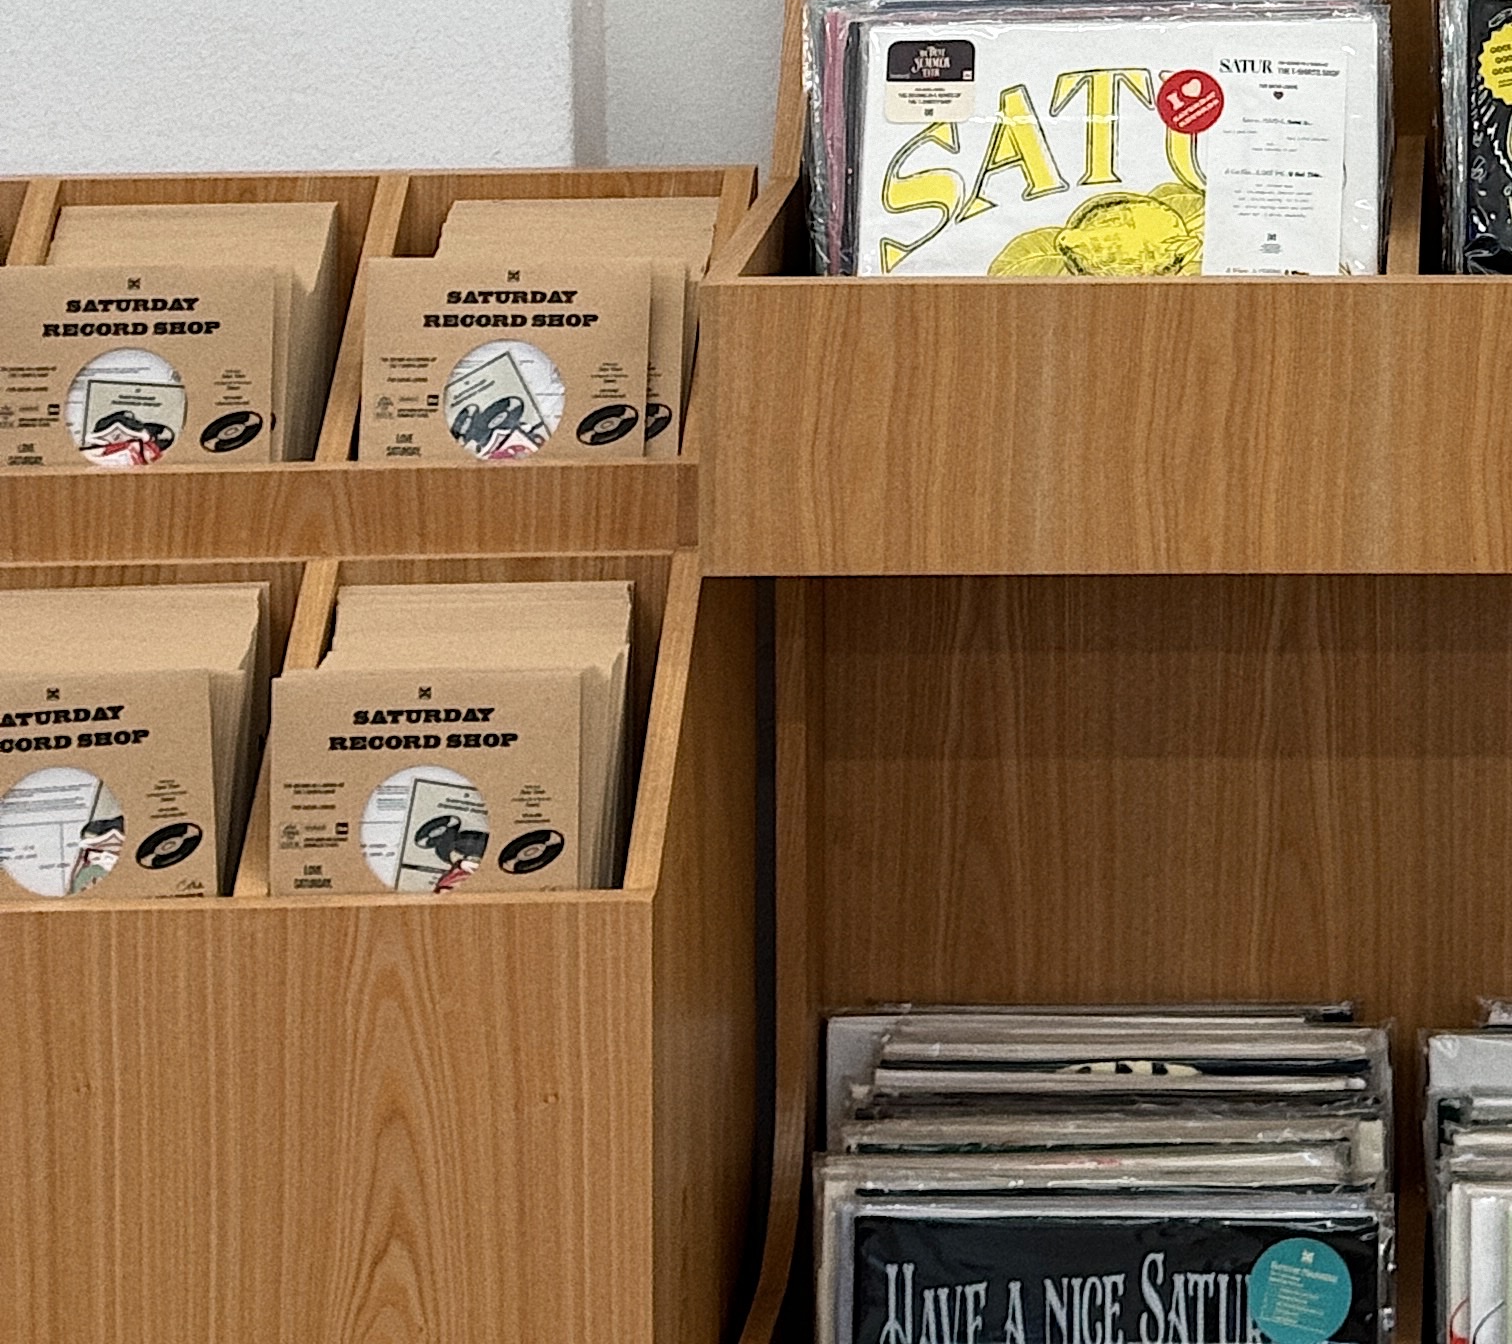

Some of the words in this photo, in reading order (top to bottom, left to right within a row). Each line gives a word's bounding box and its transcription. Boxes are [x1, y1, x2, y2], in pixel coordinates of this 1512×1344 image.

[1219, 58, 1273, 74] SATUR
[65, 296, 200, 313] SATURDAY
[447, 289, 579, 305] SATURDAY
[42, 321, 149, 339] RECORD
[152, 320, 221, 336] SHOP
[422, 313, 527, 328] RECORD
[531, 313, 600, 328] SHOP
[0, 704, 125, 728] ATURDAY
[352, 707, 496, 725] SATURDAY
[0, 735, 72, 754] CORD
[77, 728, 150, 748] SHOP
[328, 734, 442, 751] RECORD
[445, 732, 520, 749] SHOP
[879, 1262, 989, 1344] HAVE
[1003, 1279, 1027, 1344] A
[1042, 1273, 1127, 1344] NICE
[1139, 1251, 1260, 1344] SATU
